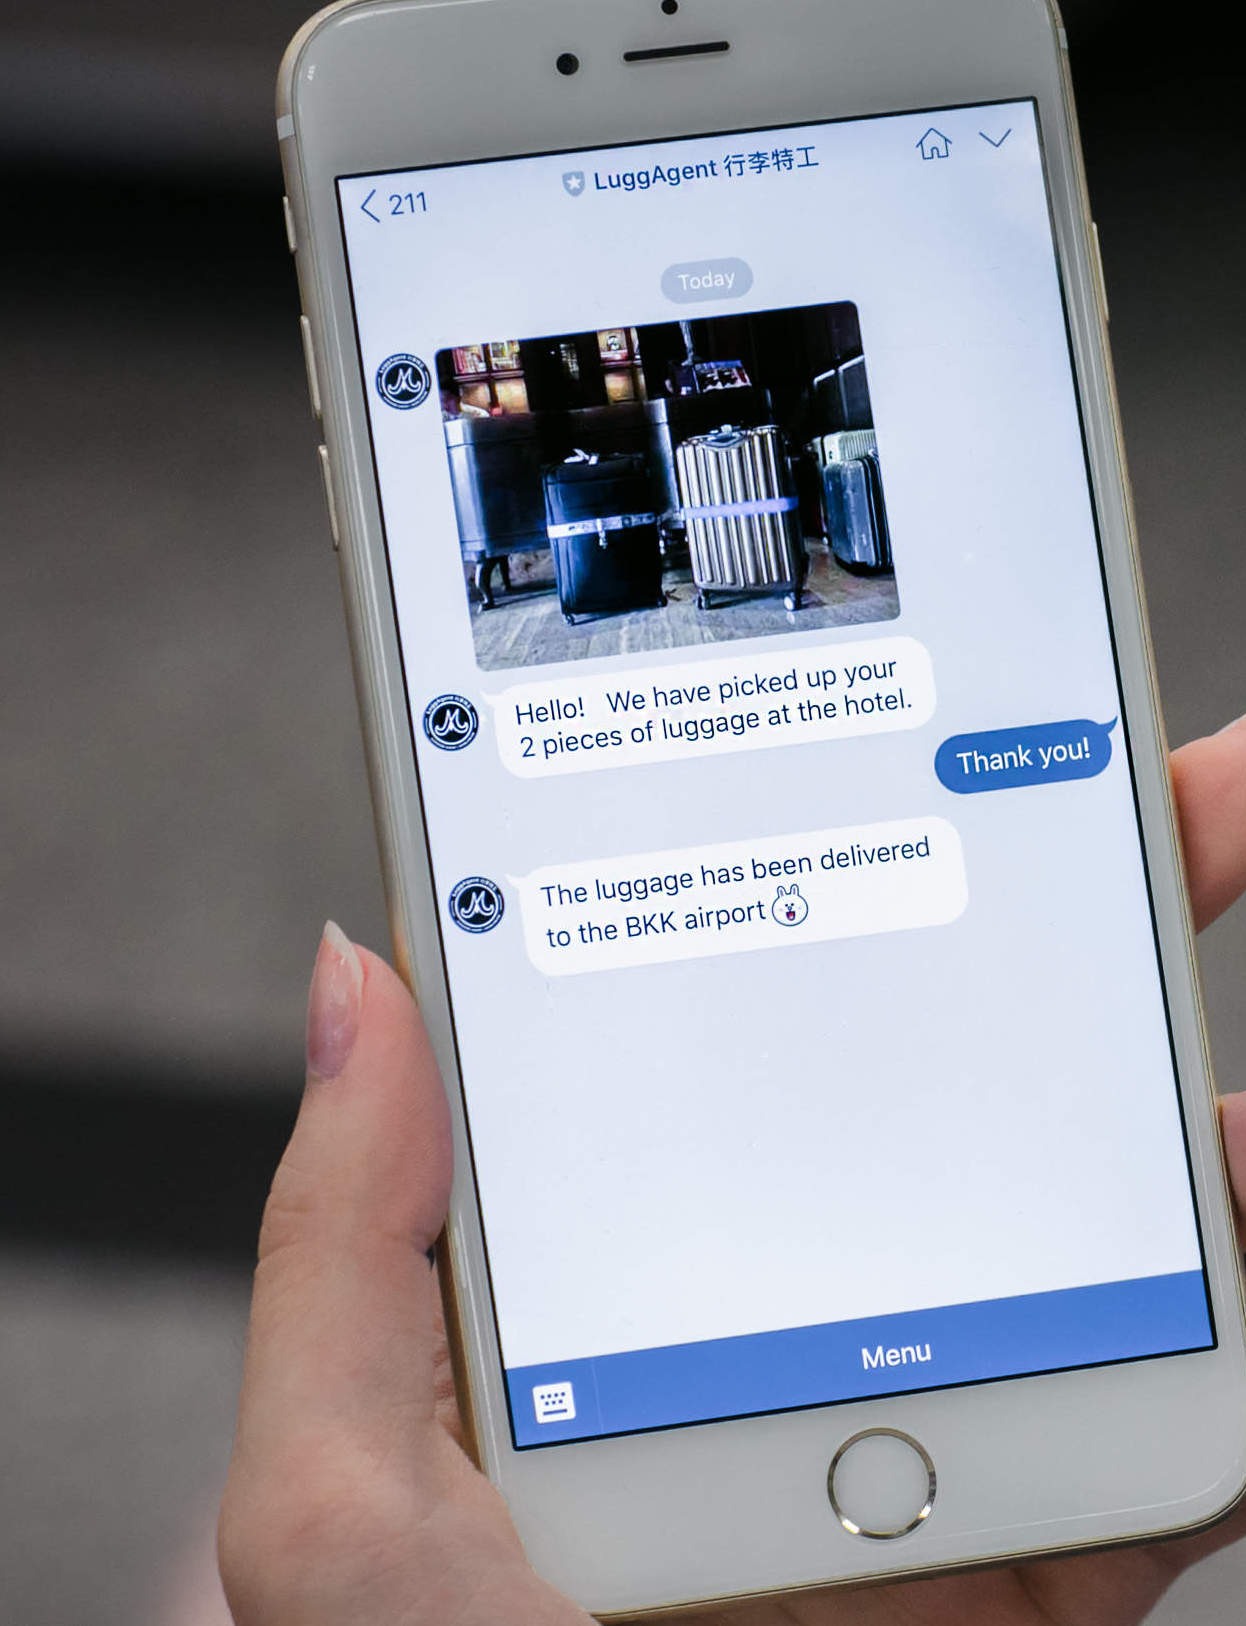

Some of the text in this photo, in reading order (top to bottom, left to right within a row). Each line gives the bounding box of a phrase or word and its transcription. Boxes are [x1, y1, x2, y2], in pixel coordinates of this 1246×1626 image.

[594, 145, 820, 192] LuggAgent 行李特工
[388, 191, 427, 216] 211
[677, 270, 735, 291] Today
[515, 661, 897, 726] Hello! We have picked up your
[520, 687, 912, 760] 2 pieces of luggage at the hotel.
[956, 736, 1091, 775] Thank you!
[540, 835, 930, 907] The luggage has been delivered
[546, 900, 767, 948] to the BKK airport
[861, 1343, 932, 1370] Menu
